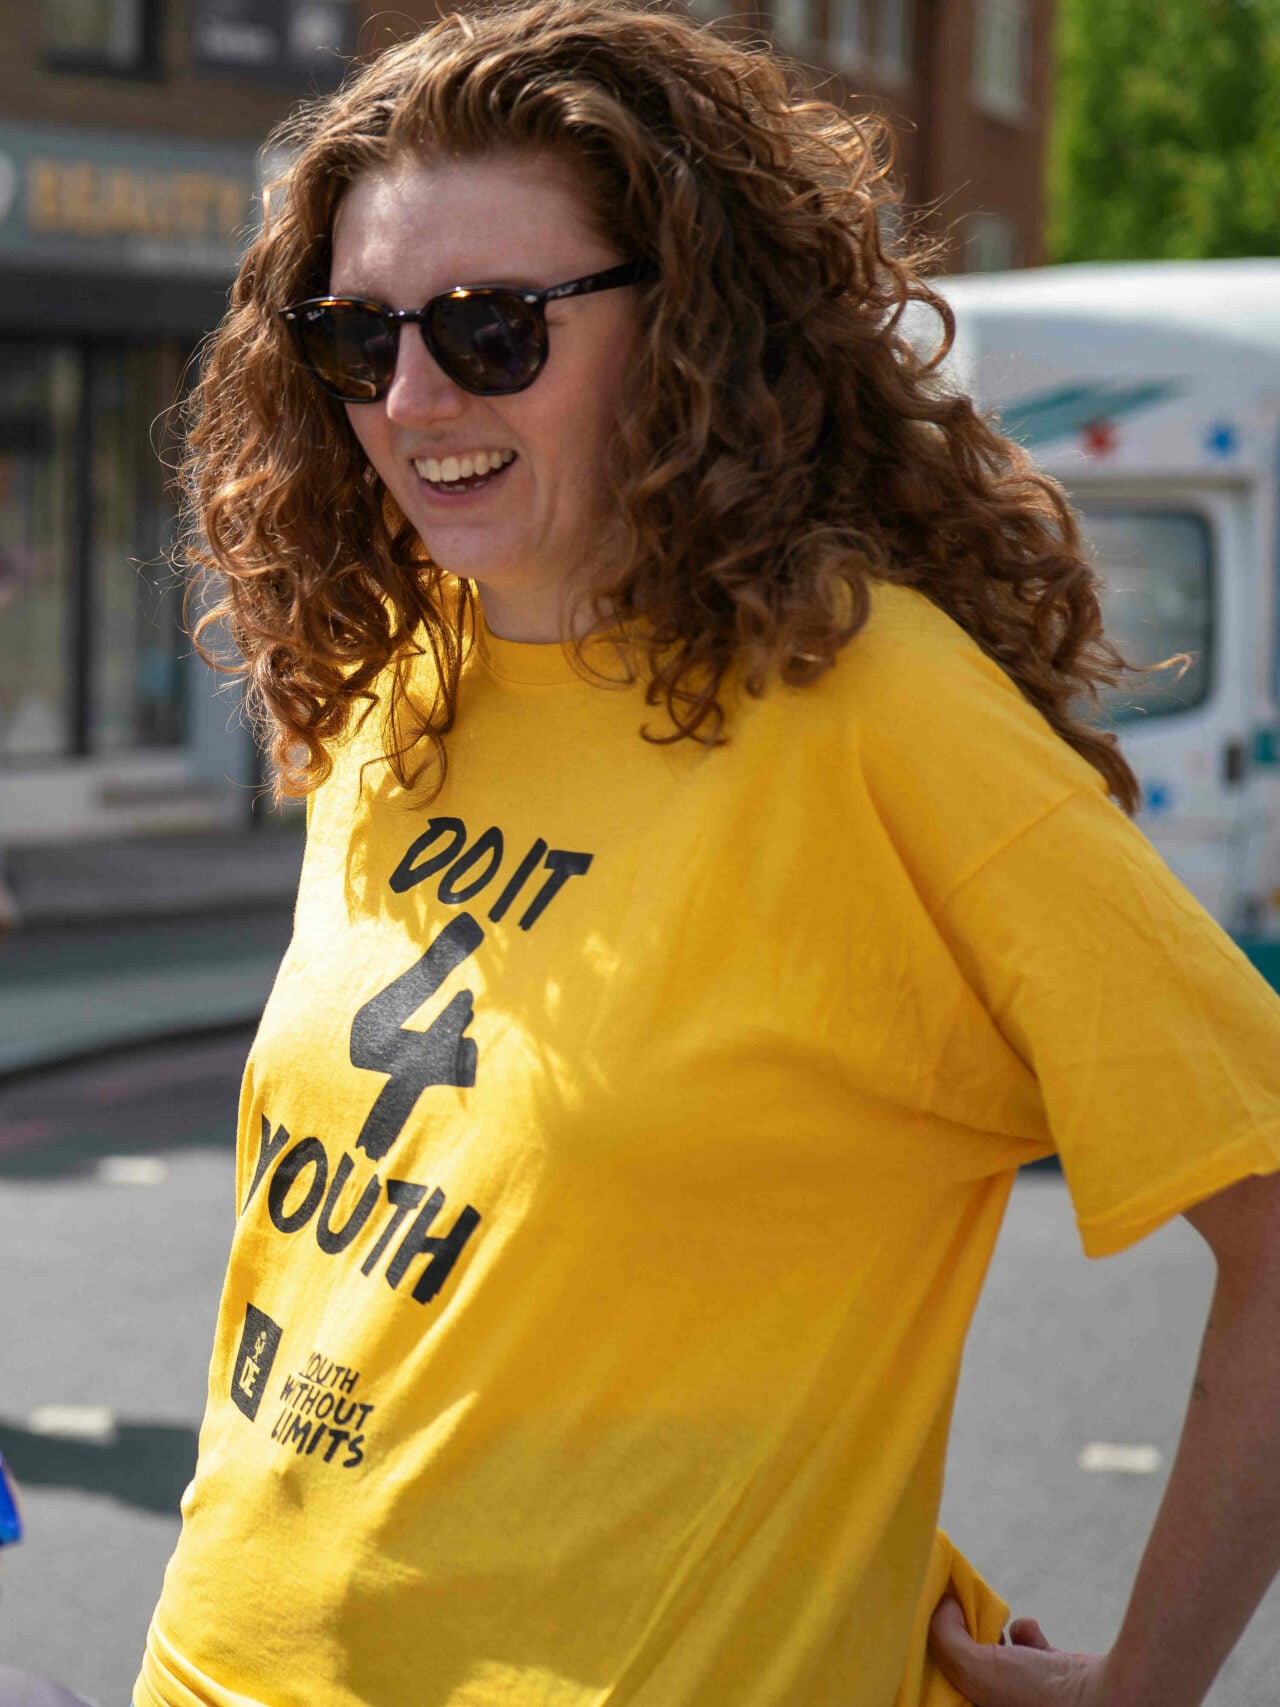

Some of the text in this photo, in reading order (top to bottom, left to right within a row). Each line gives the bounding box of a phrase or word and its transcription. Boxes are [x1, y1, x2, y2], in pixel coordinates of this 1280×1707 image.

[389, 817, 594, 931] DO IT
[350, 911, 485, 1162] 4
[241, 1112, 482, 1306] YOUTH
[271, 1408, 365, 1469] LIMITS
